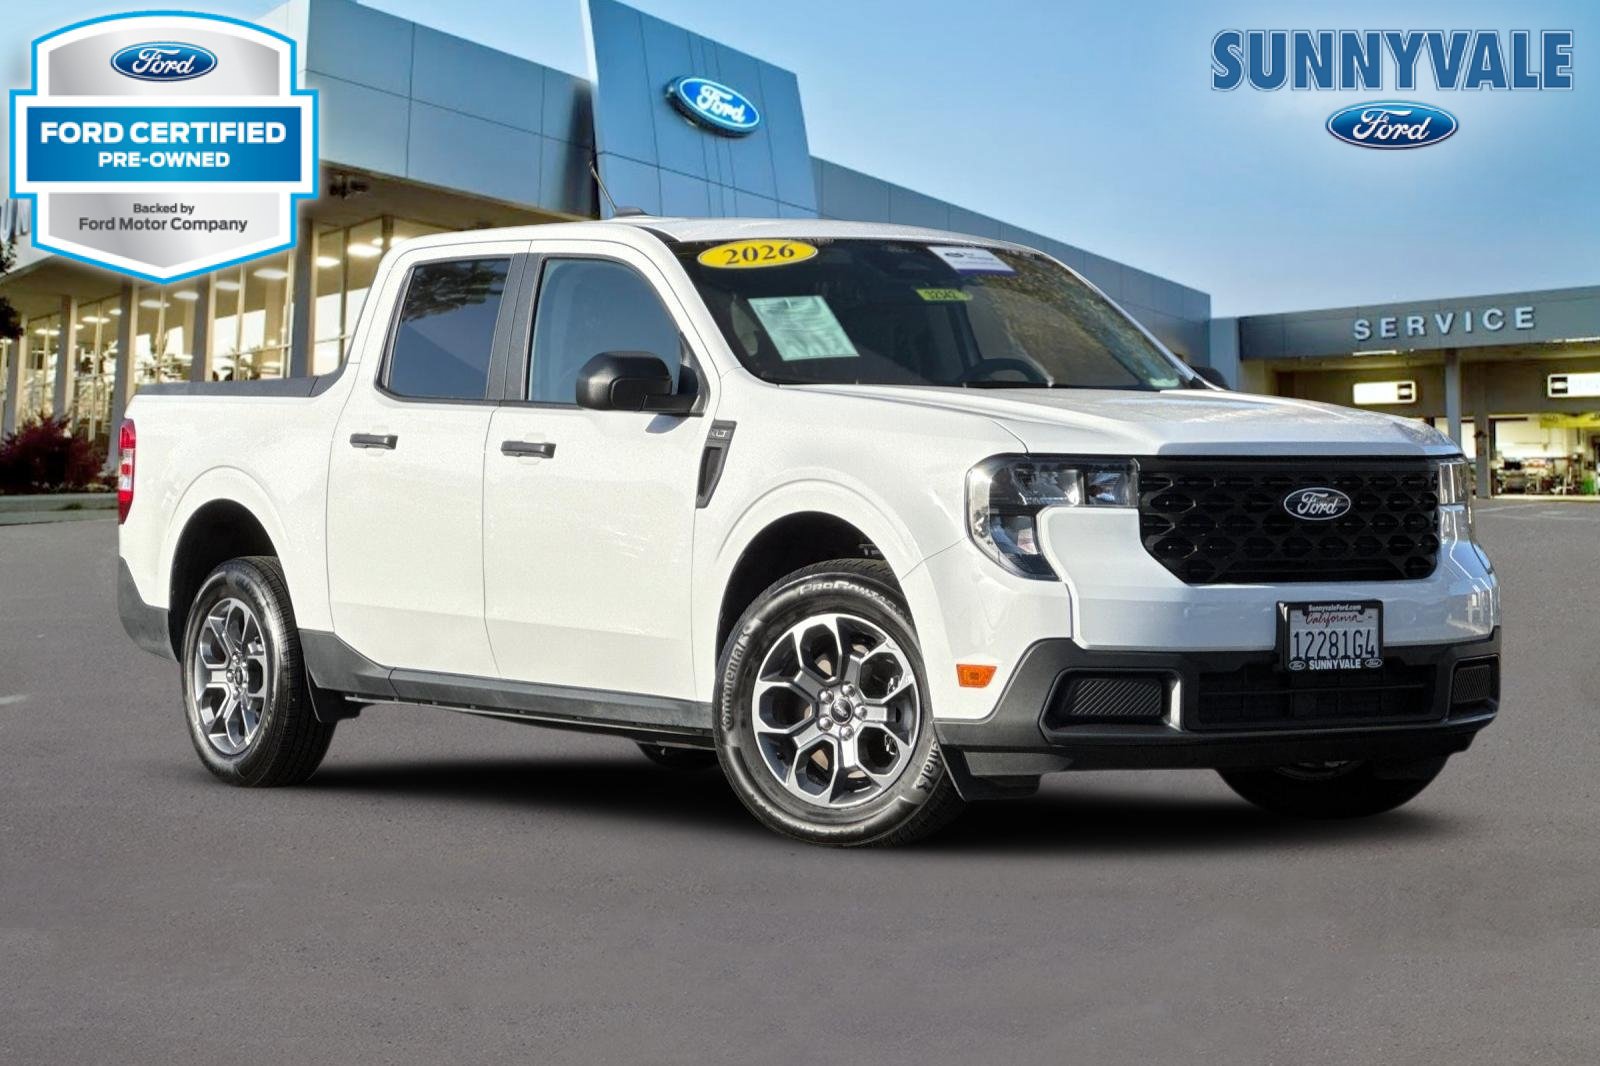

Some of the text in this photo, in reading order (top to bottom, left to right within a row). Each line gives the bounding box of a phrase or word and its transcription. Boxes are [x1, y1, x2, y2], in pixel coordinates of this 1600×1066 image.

[696, 84, 747, 123] Ford
[723, 243, 795, 265] 2026
[1353, 306, 1536, 341] SERVICE
[1297, 491, 1338, 515] Ford
[1305, 612, 1363, 628] California
[1293, 629, 1376, 659] 12281G4
[1309, 659, 1361, 670] SUNNYVALE
